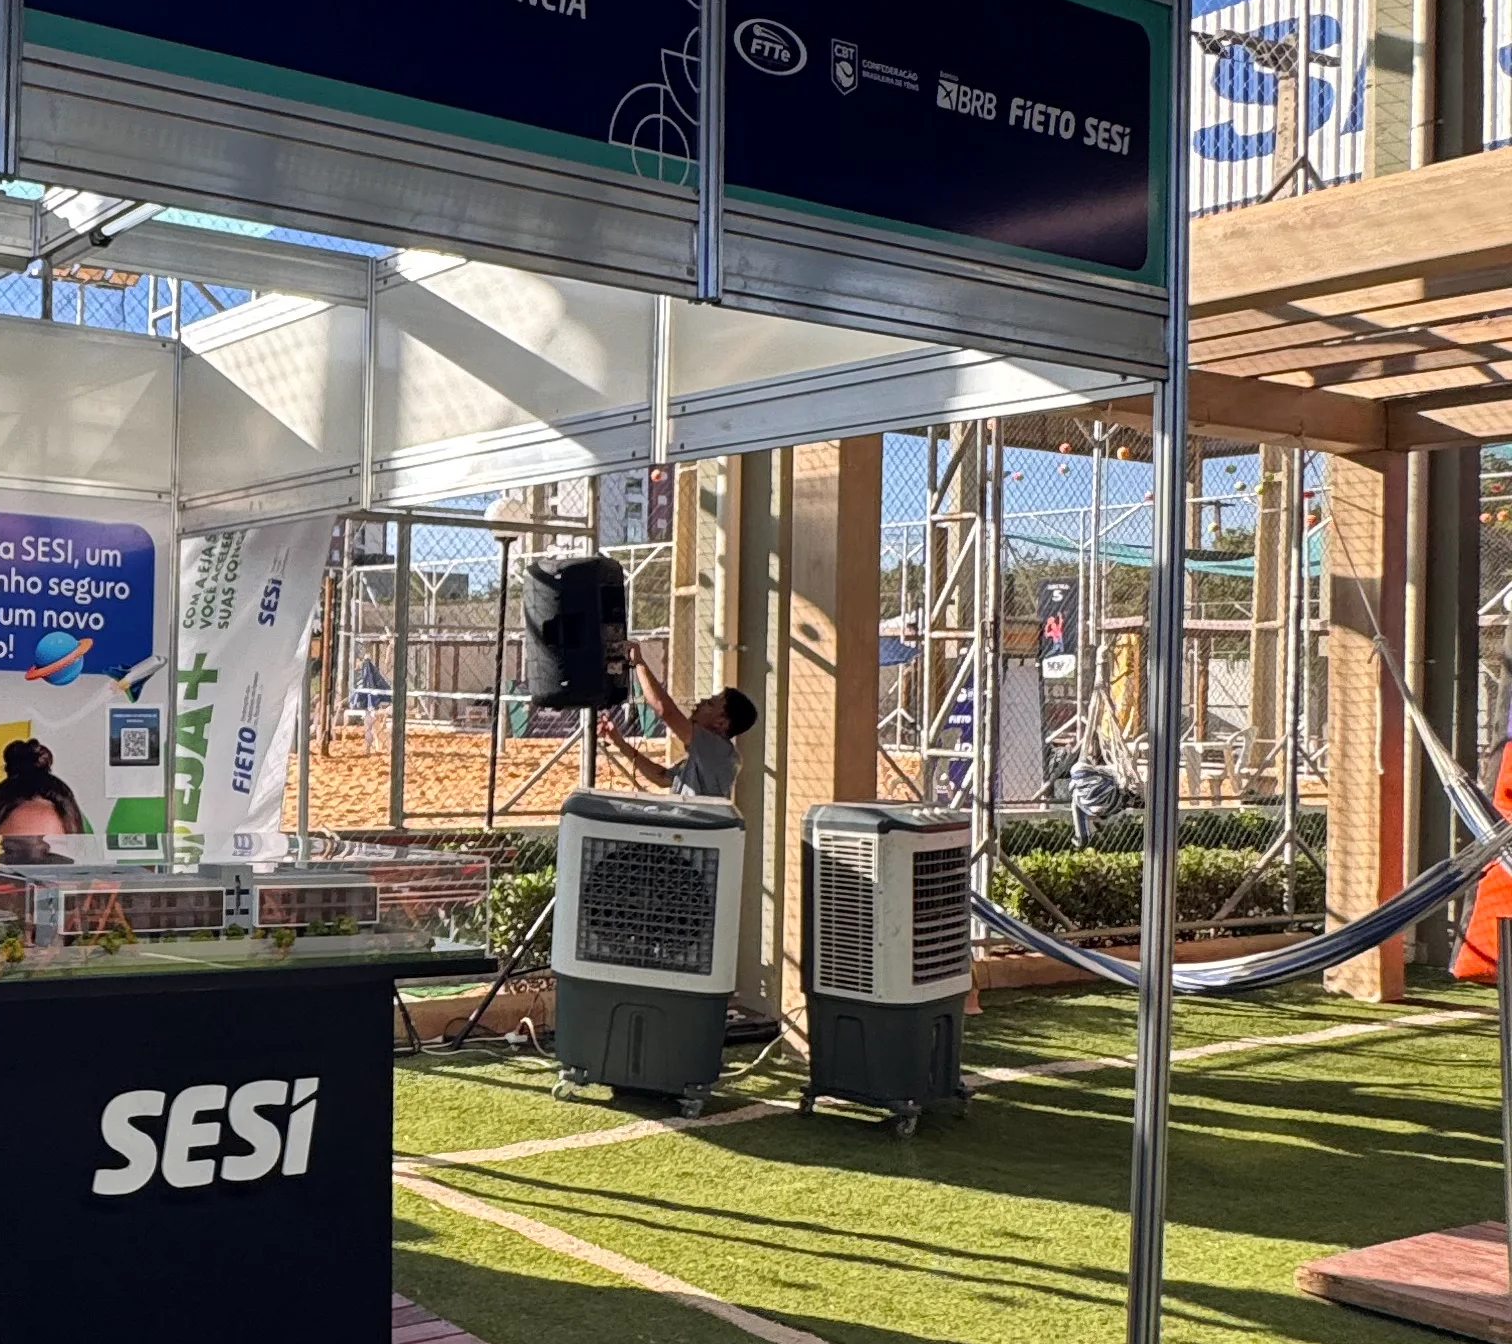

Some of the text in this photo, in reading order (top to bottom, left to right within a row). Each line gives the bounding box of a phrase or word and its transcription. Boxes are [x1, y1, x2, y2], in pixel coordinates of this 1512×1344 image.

[833, 44, 856, 61] CBT
[957, 85, 997, 121] BRB
[21, 535, 80, 570] SESI,
[85, 546, 122, 568] um
[47, 576, 131, 605] seguro
[42, 608, 105, 631] novo
